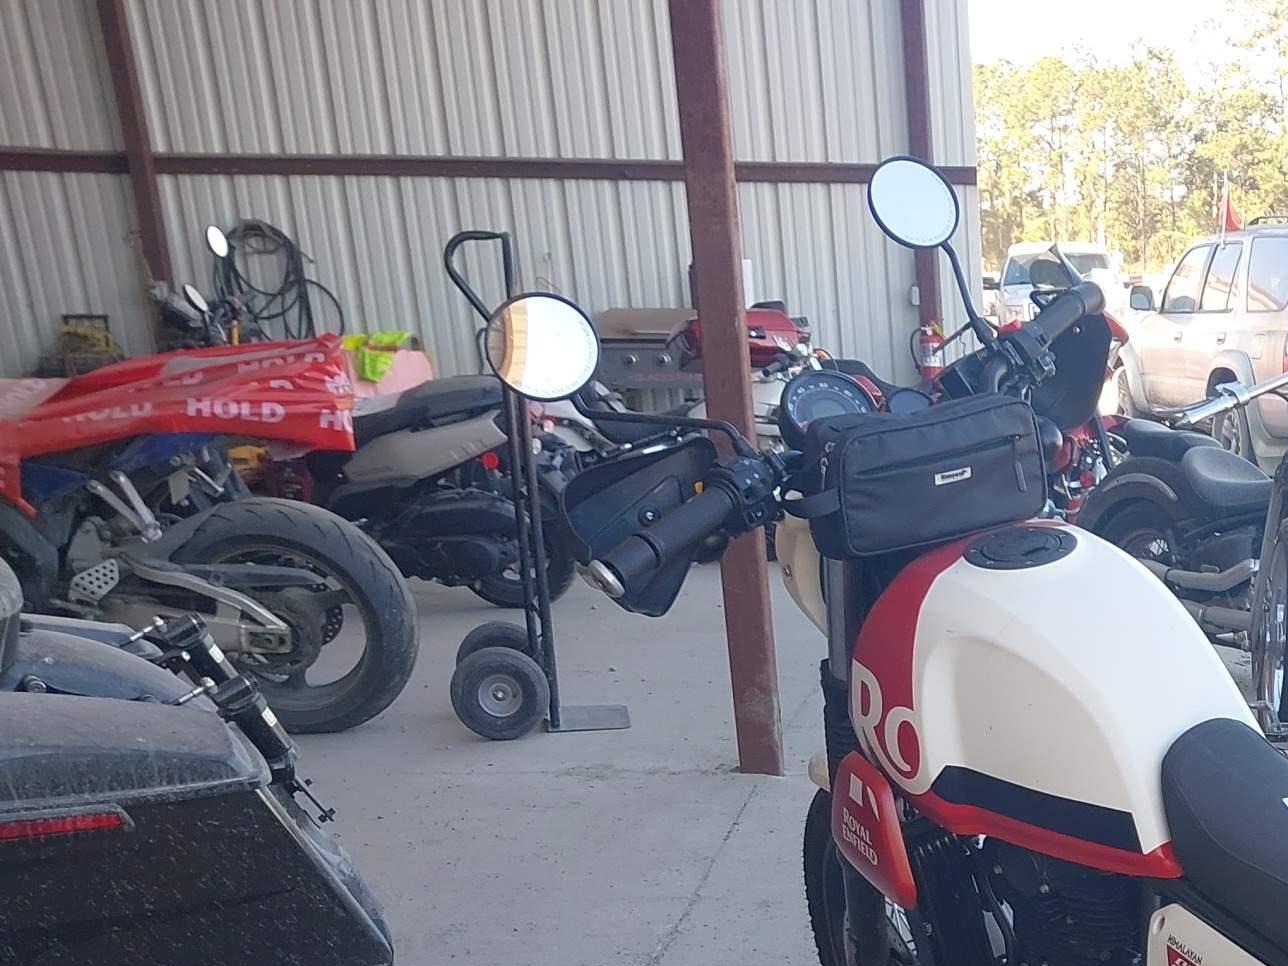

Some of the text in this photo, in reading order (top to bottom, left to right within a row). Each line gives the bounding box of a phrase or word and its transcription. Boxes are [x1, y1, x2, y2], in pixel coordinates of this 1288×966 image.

[186, 398, 285, 423] HOLD
[843, 807, 873, 846] ROYAL
[842, 825, 878, 866] ENFIELD
[1167, 934, 1203, 965] HIMALAYAN
